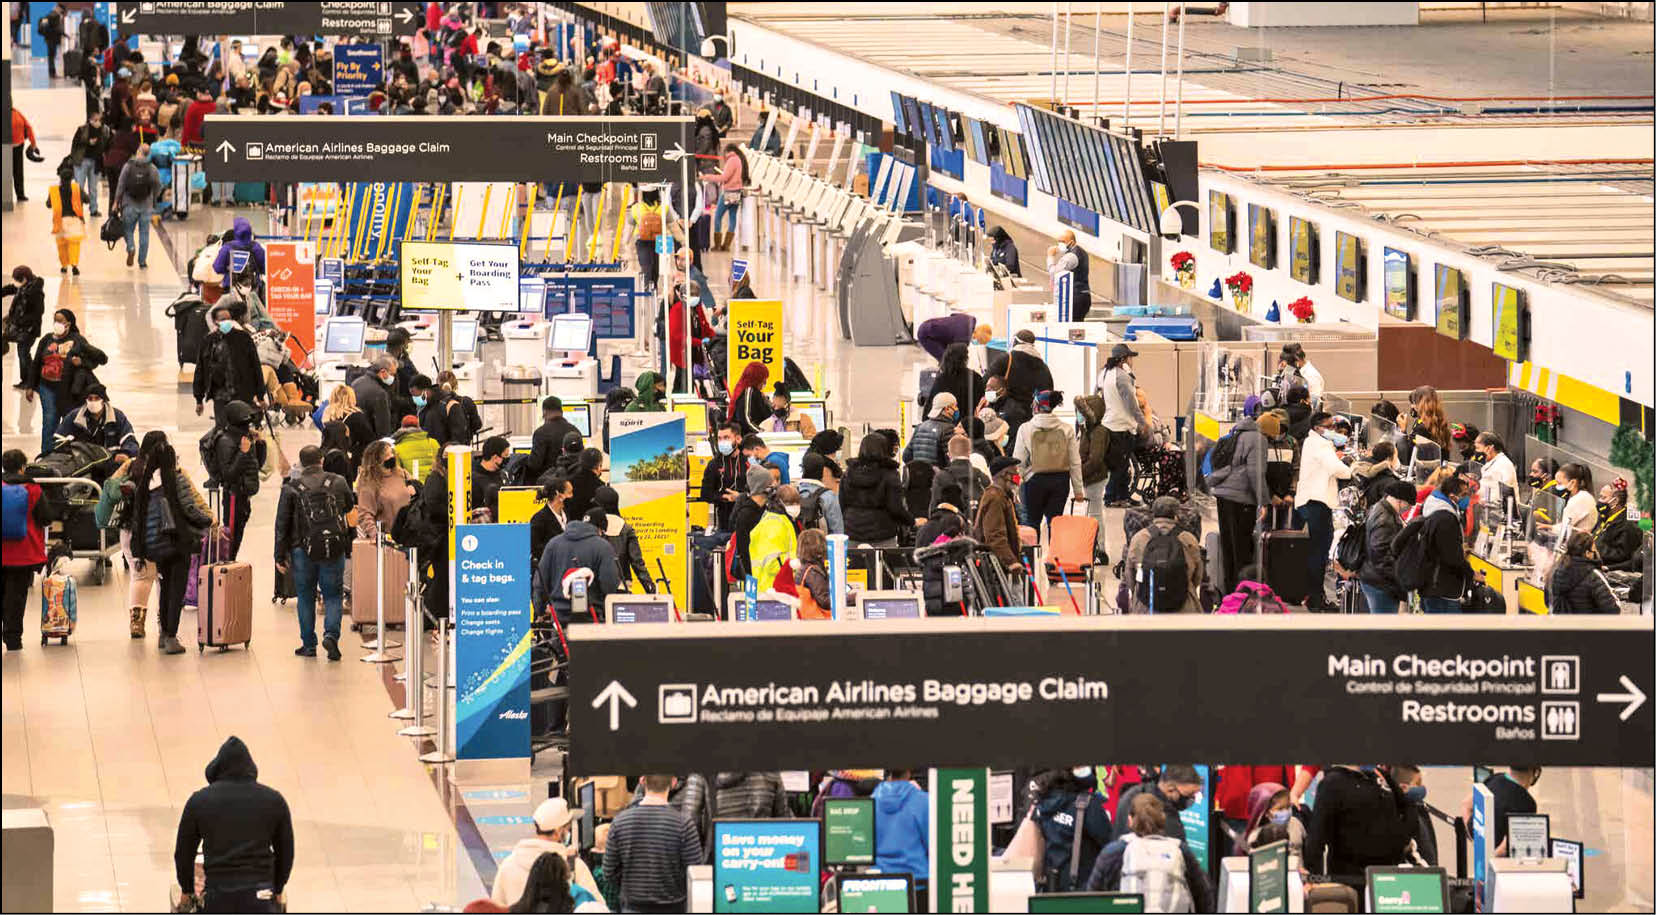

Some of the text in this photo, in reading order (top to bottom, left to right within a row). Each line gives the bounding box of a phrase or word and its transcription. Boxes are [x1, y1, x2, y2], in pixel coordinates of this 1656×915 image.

[322, 19, 376, 28] Restrooms
[336, 61, 360, 72] Fly By
[336, 72, 367, 81] Priority
[548, 133, 638, 144] Main Checkpoint
[266, 143, 450, 154] American Airlines Baggage Claim
[580, 154, 638, 163] Restrooms
[488, 260, 508, 268] Your
[470, 269, 511, 279] Boarding
[412, 277, 428, 286] Bag
[737, 320, 774, 330] Self-Tag
[737, 330, 774, 342] Your
[738, 344, 774, 364] Bag
[461, 560, 504, 570] Check in
[462, 573, 516, 584] & tag bags.
[461, 628, 484, 636] Change
[1328, 654, 1536, 680] Main Checkpoint
[701, 677, 1108, 706] American Airlines Baggage Claim
[1346, 680, 1536, 695] Control de Seguridad Principal
[702, 706, 940, 722] Reclamo de Equipaje American Airlines
[1402, 700, 1536, 722] Restrooms
[1496, 726, 1536, 740] Baños
[952, 778, 975, 867] NEED
[722, 834, 805, 847] Save money
[722, 847, 775, 859] on your
[842, 879, 907, 892] FRONTIER
